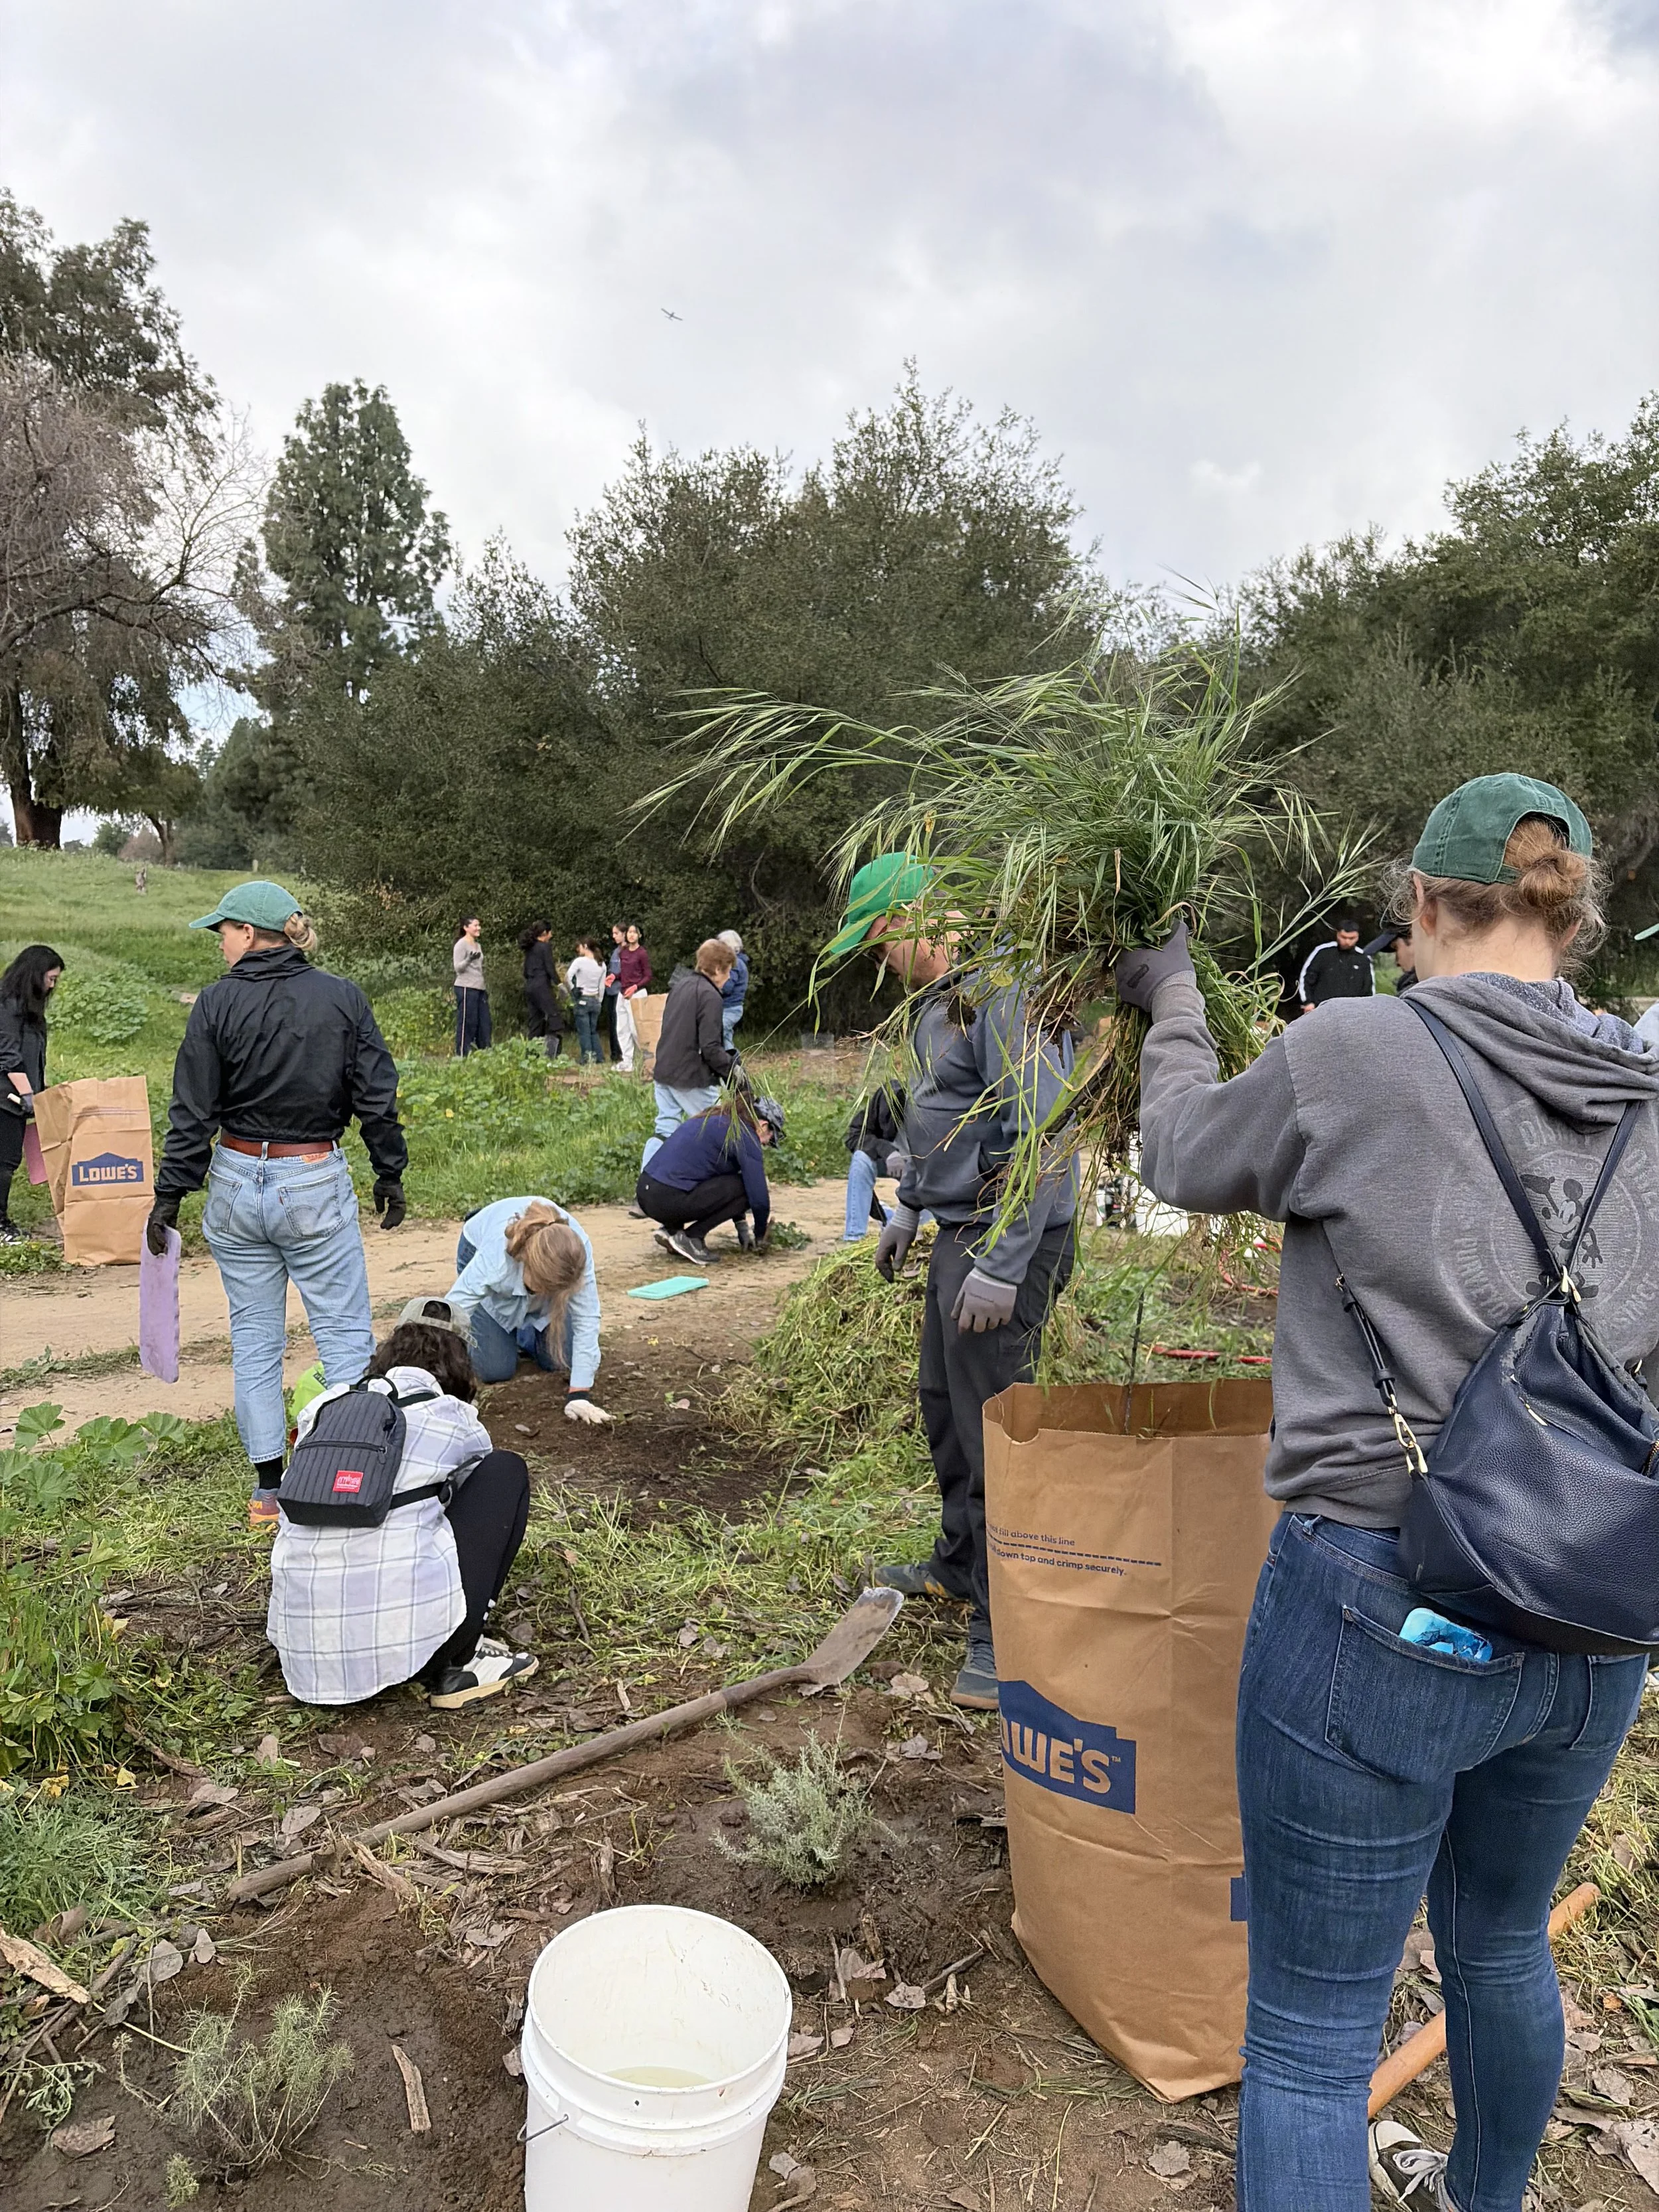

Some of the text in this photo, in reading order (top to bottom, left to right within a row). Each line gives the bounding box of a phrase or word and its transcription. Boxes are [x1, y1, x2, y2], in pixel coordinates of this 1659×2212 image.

[79, 1163, 137, 1182] LOWE'S
[999, 1527, 1009, 1537] fill
[1011, 1530, 1039, 1540] above
[1041, 1534, 1057, 1544] this
[1058, 1537, 1075, 1546] line
[997, 1548, 1019, 1558] down
[1021, 1552, 1036, 1562] top
[1037, 1557, 1054, 1566] and
[1056, 1560, 1083, 1570] crimp
[1085, 1563, 1127, 1576] securely.
[1001, 1717, 1112, 1794] WE'S
